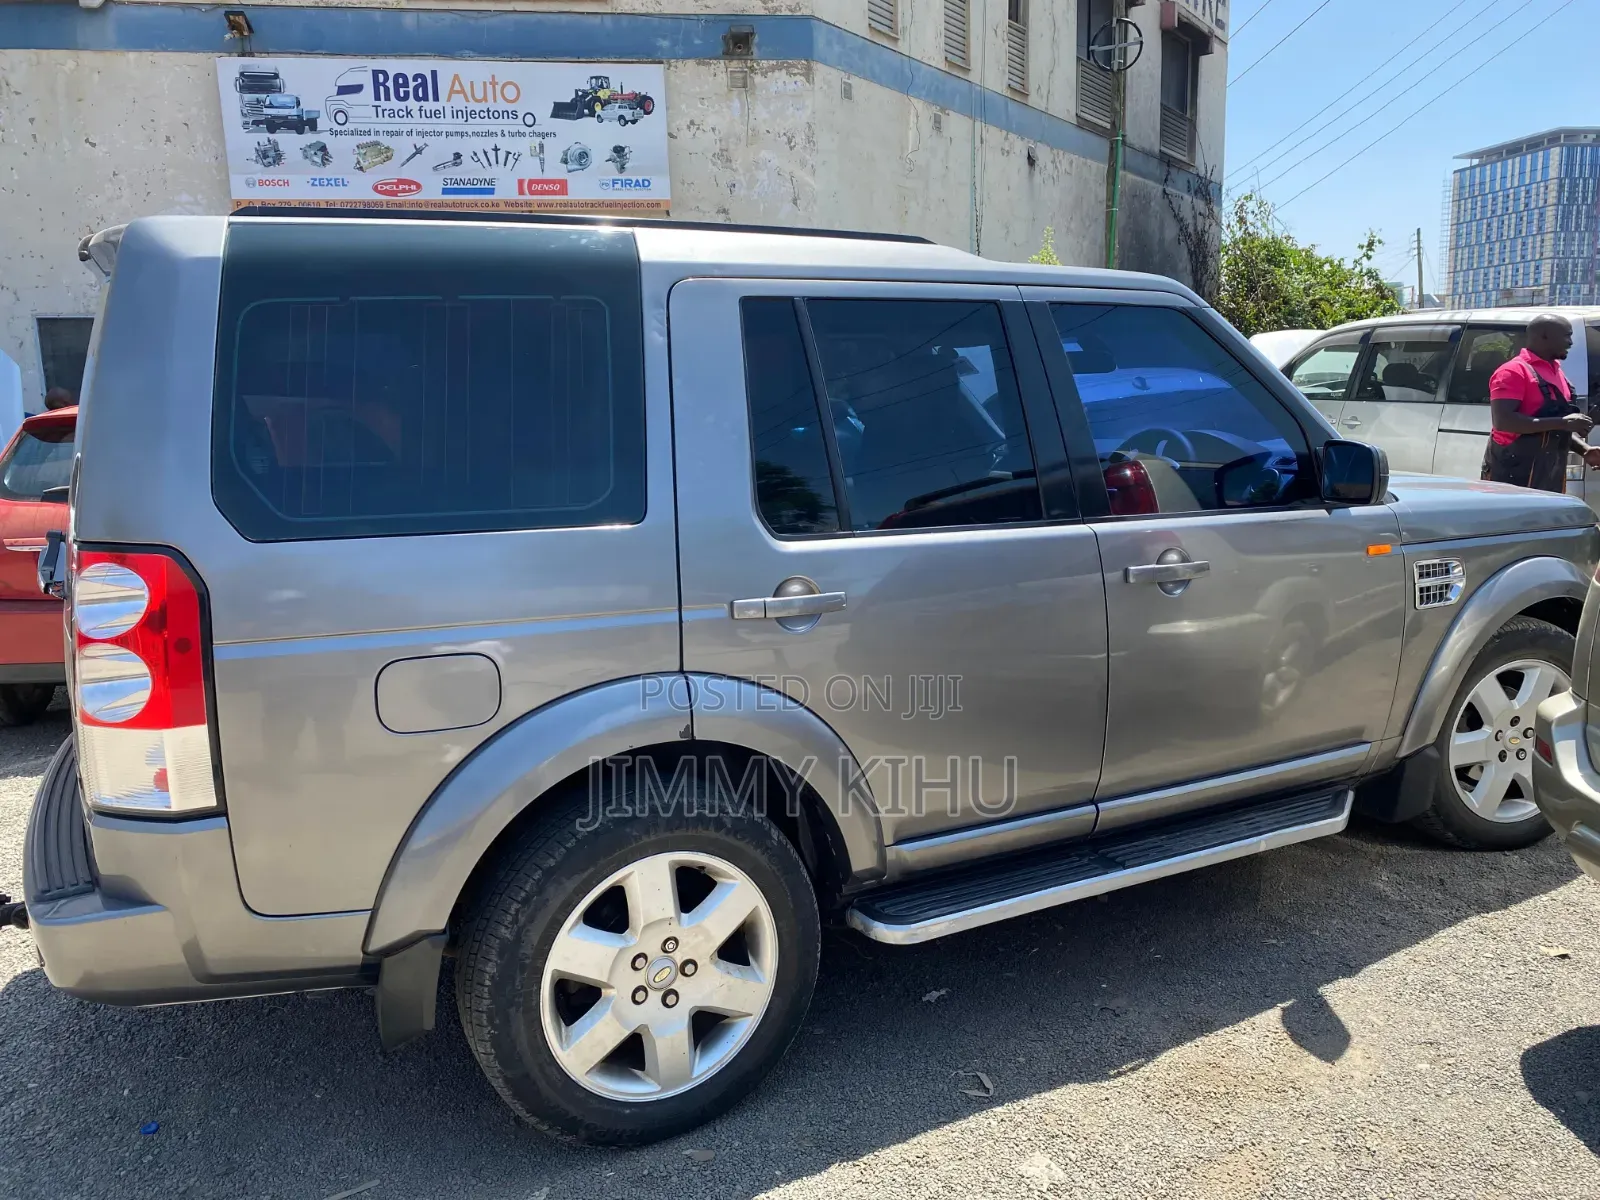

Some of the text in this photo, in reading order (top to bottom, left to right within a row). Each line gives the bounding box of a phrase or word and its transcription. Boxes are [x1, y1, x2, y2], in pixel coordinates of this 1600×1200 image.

[371, 69, 521, 104] Real Auto
[371, 105, 518, 122] Track fuel injectons
[329, 128, 371, 138] Specialized
[373, 128, 380, 137] in
[382, 128, 404, 138] repair
[405, 128, 413, 137] of
[415, 129, 443, 138] injector
[500, 130, 506, 138] &
[508, 129, 526, 138] turbo
[528, 130, 557, 139] chagers
[257, 179, 290, 187] BOSCH
[310, 177, 348, 187] ZEXEL
[442, 178, 496, 187] STANADYNE
[611, 178, 651, 188] FIRAD
[531, 184, 560, 192] DENSO
[504, 201, 535, 209] Website:
